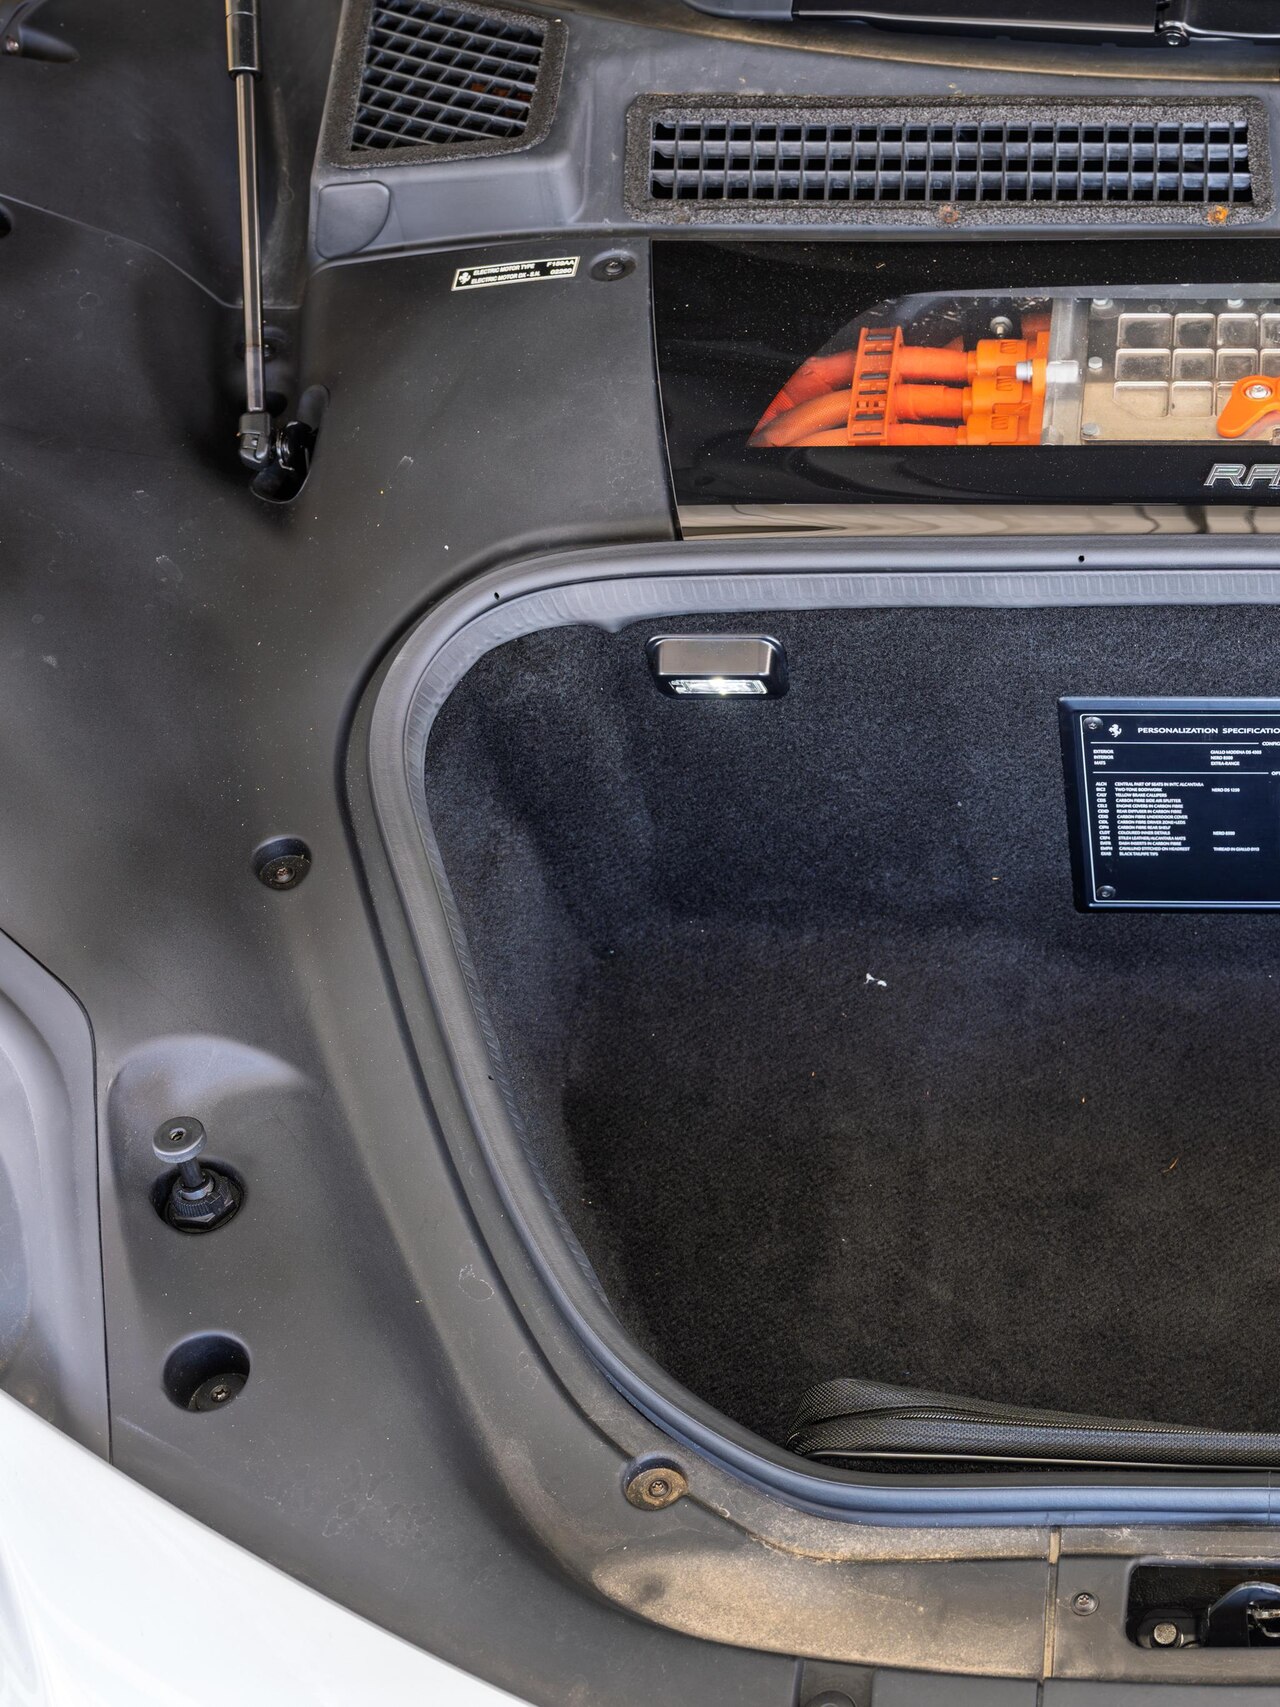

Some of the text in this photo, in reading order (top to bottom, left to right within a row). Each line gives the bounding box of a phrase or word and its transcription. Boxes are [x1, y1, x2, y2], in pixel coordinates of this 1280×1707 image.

[473, 268, 500, 276] ELECTRIC
[471, 276, 498, 284] ELECTRIC
[498, 273, 518, 281] MOTOR
